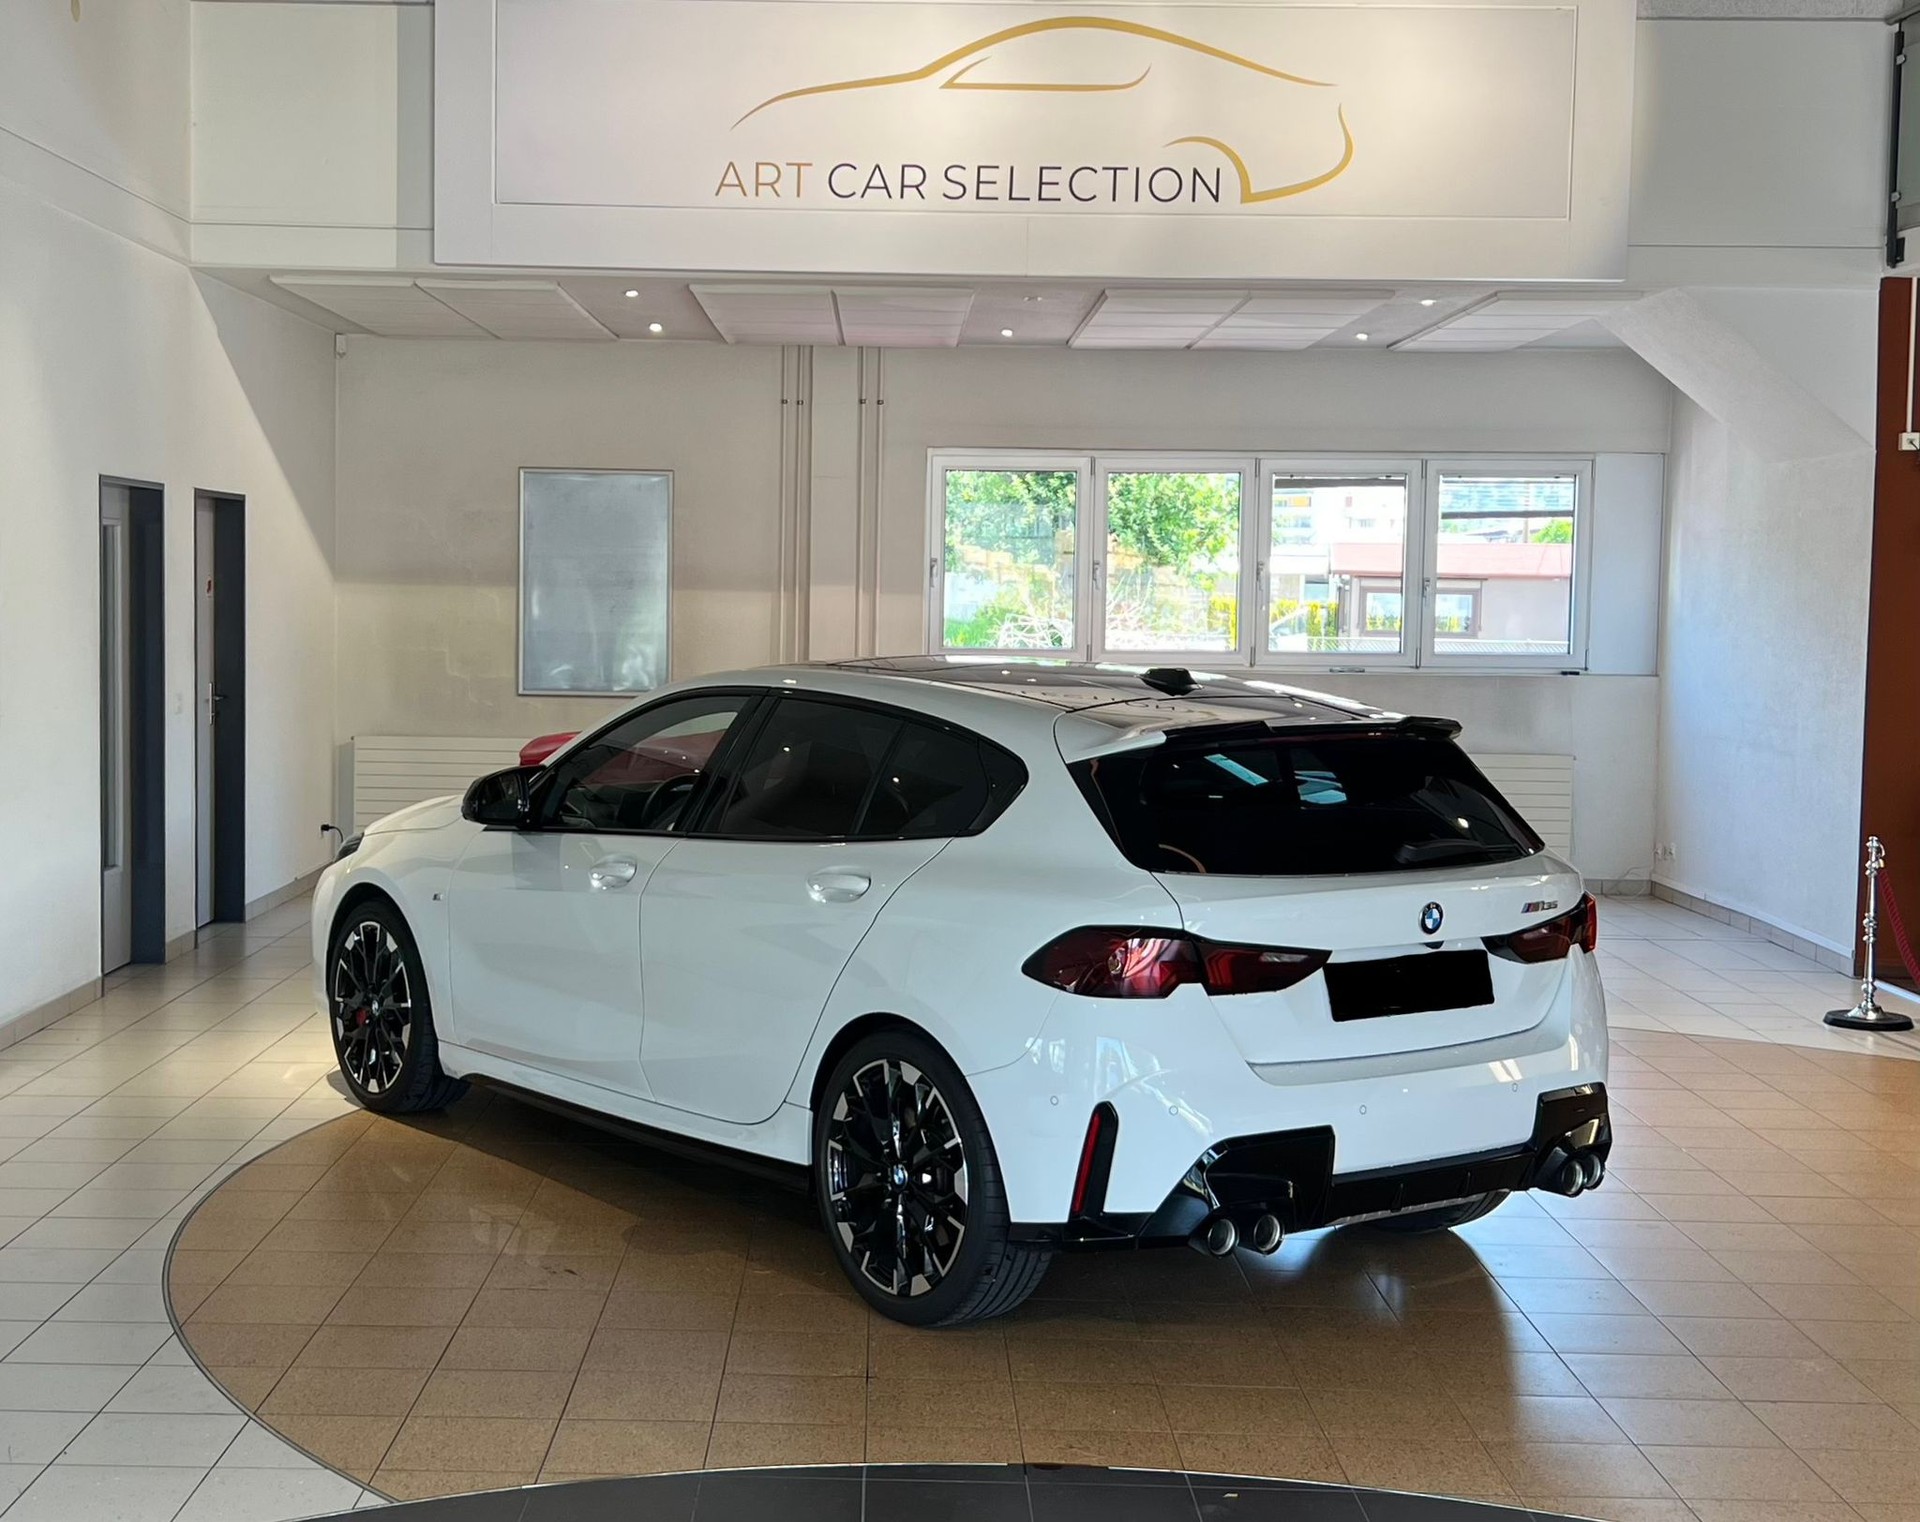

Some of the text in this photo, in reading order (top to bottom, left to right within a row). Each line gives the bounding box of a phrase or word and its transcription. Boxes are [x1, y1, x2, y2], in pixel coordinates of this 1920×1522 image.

[715, 161, 1221, 203] ART CAR SELECTION
